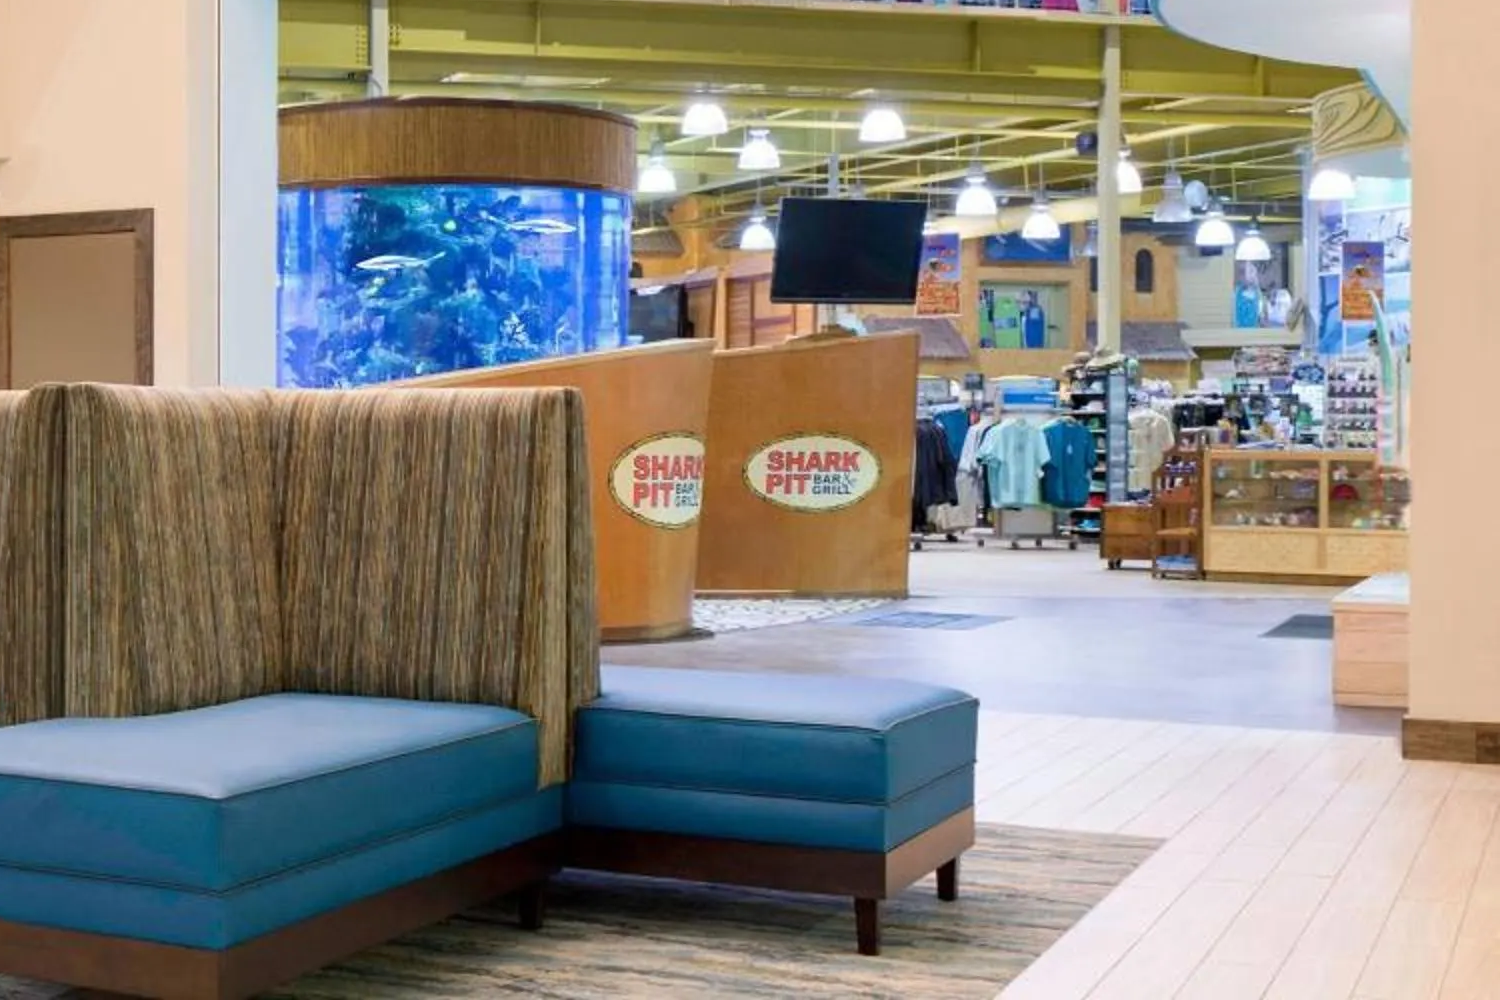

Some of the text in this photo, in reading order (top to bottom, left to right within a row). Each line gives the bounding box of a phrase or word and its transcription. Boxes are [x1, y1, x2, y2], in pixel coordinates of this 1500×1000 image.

[767, 450, 861, 472] SHARK
[632, 482, 675, 508] PIT
[764, 474, 811, 494] PIT
